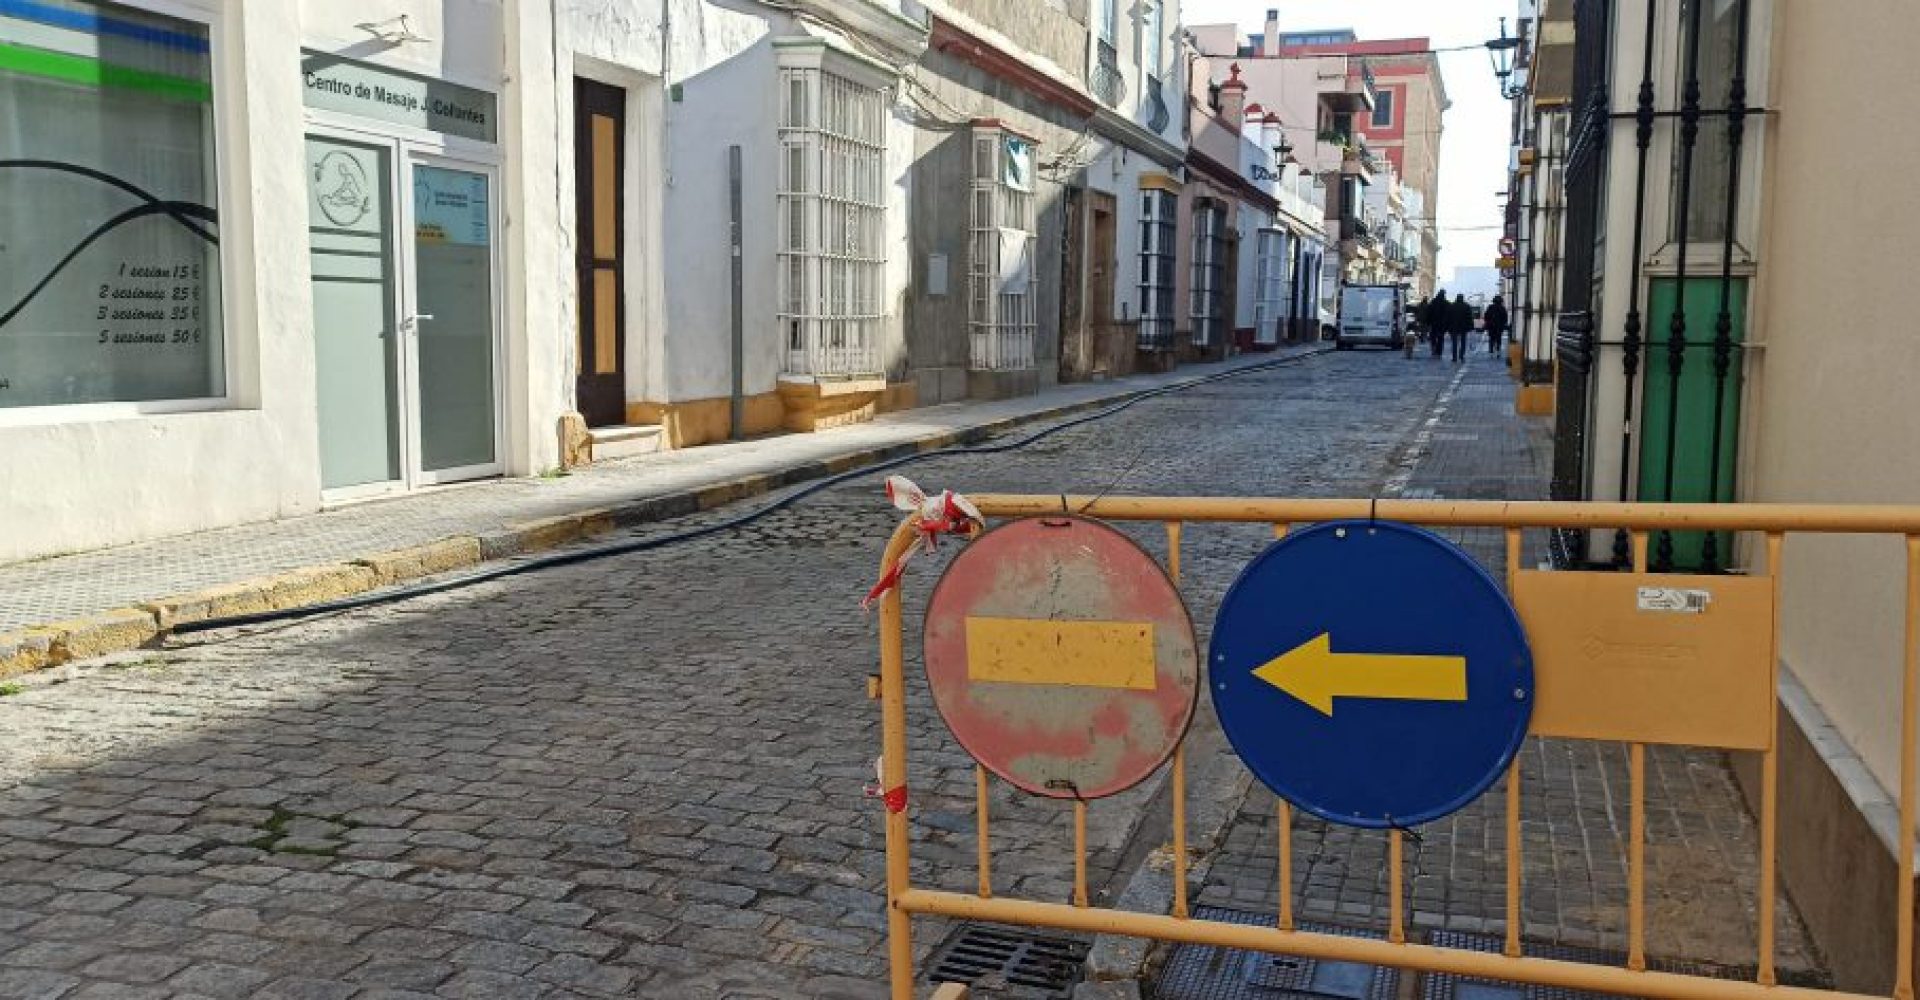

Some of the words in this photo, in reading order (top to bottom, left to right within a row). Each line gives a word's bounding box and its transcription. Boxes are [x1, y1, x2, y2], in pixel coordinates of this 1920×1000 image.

[305, 71, 352, 96] Centro
[354, 81, 371, 100] de
[374, 85, 418, 112] Masaje
[172, 264, 189, 279] 15
[99, 284, 110, 299] 2
[171, 286, 189, 301] 25
[97, 305, 109, 320] 3
[170, 305, 189, 320] 35
[98, 329, 110, 343] 5
[171, 329, 189, 343] 50
